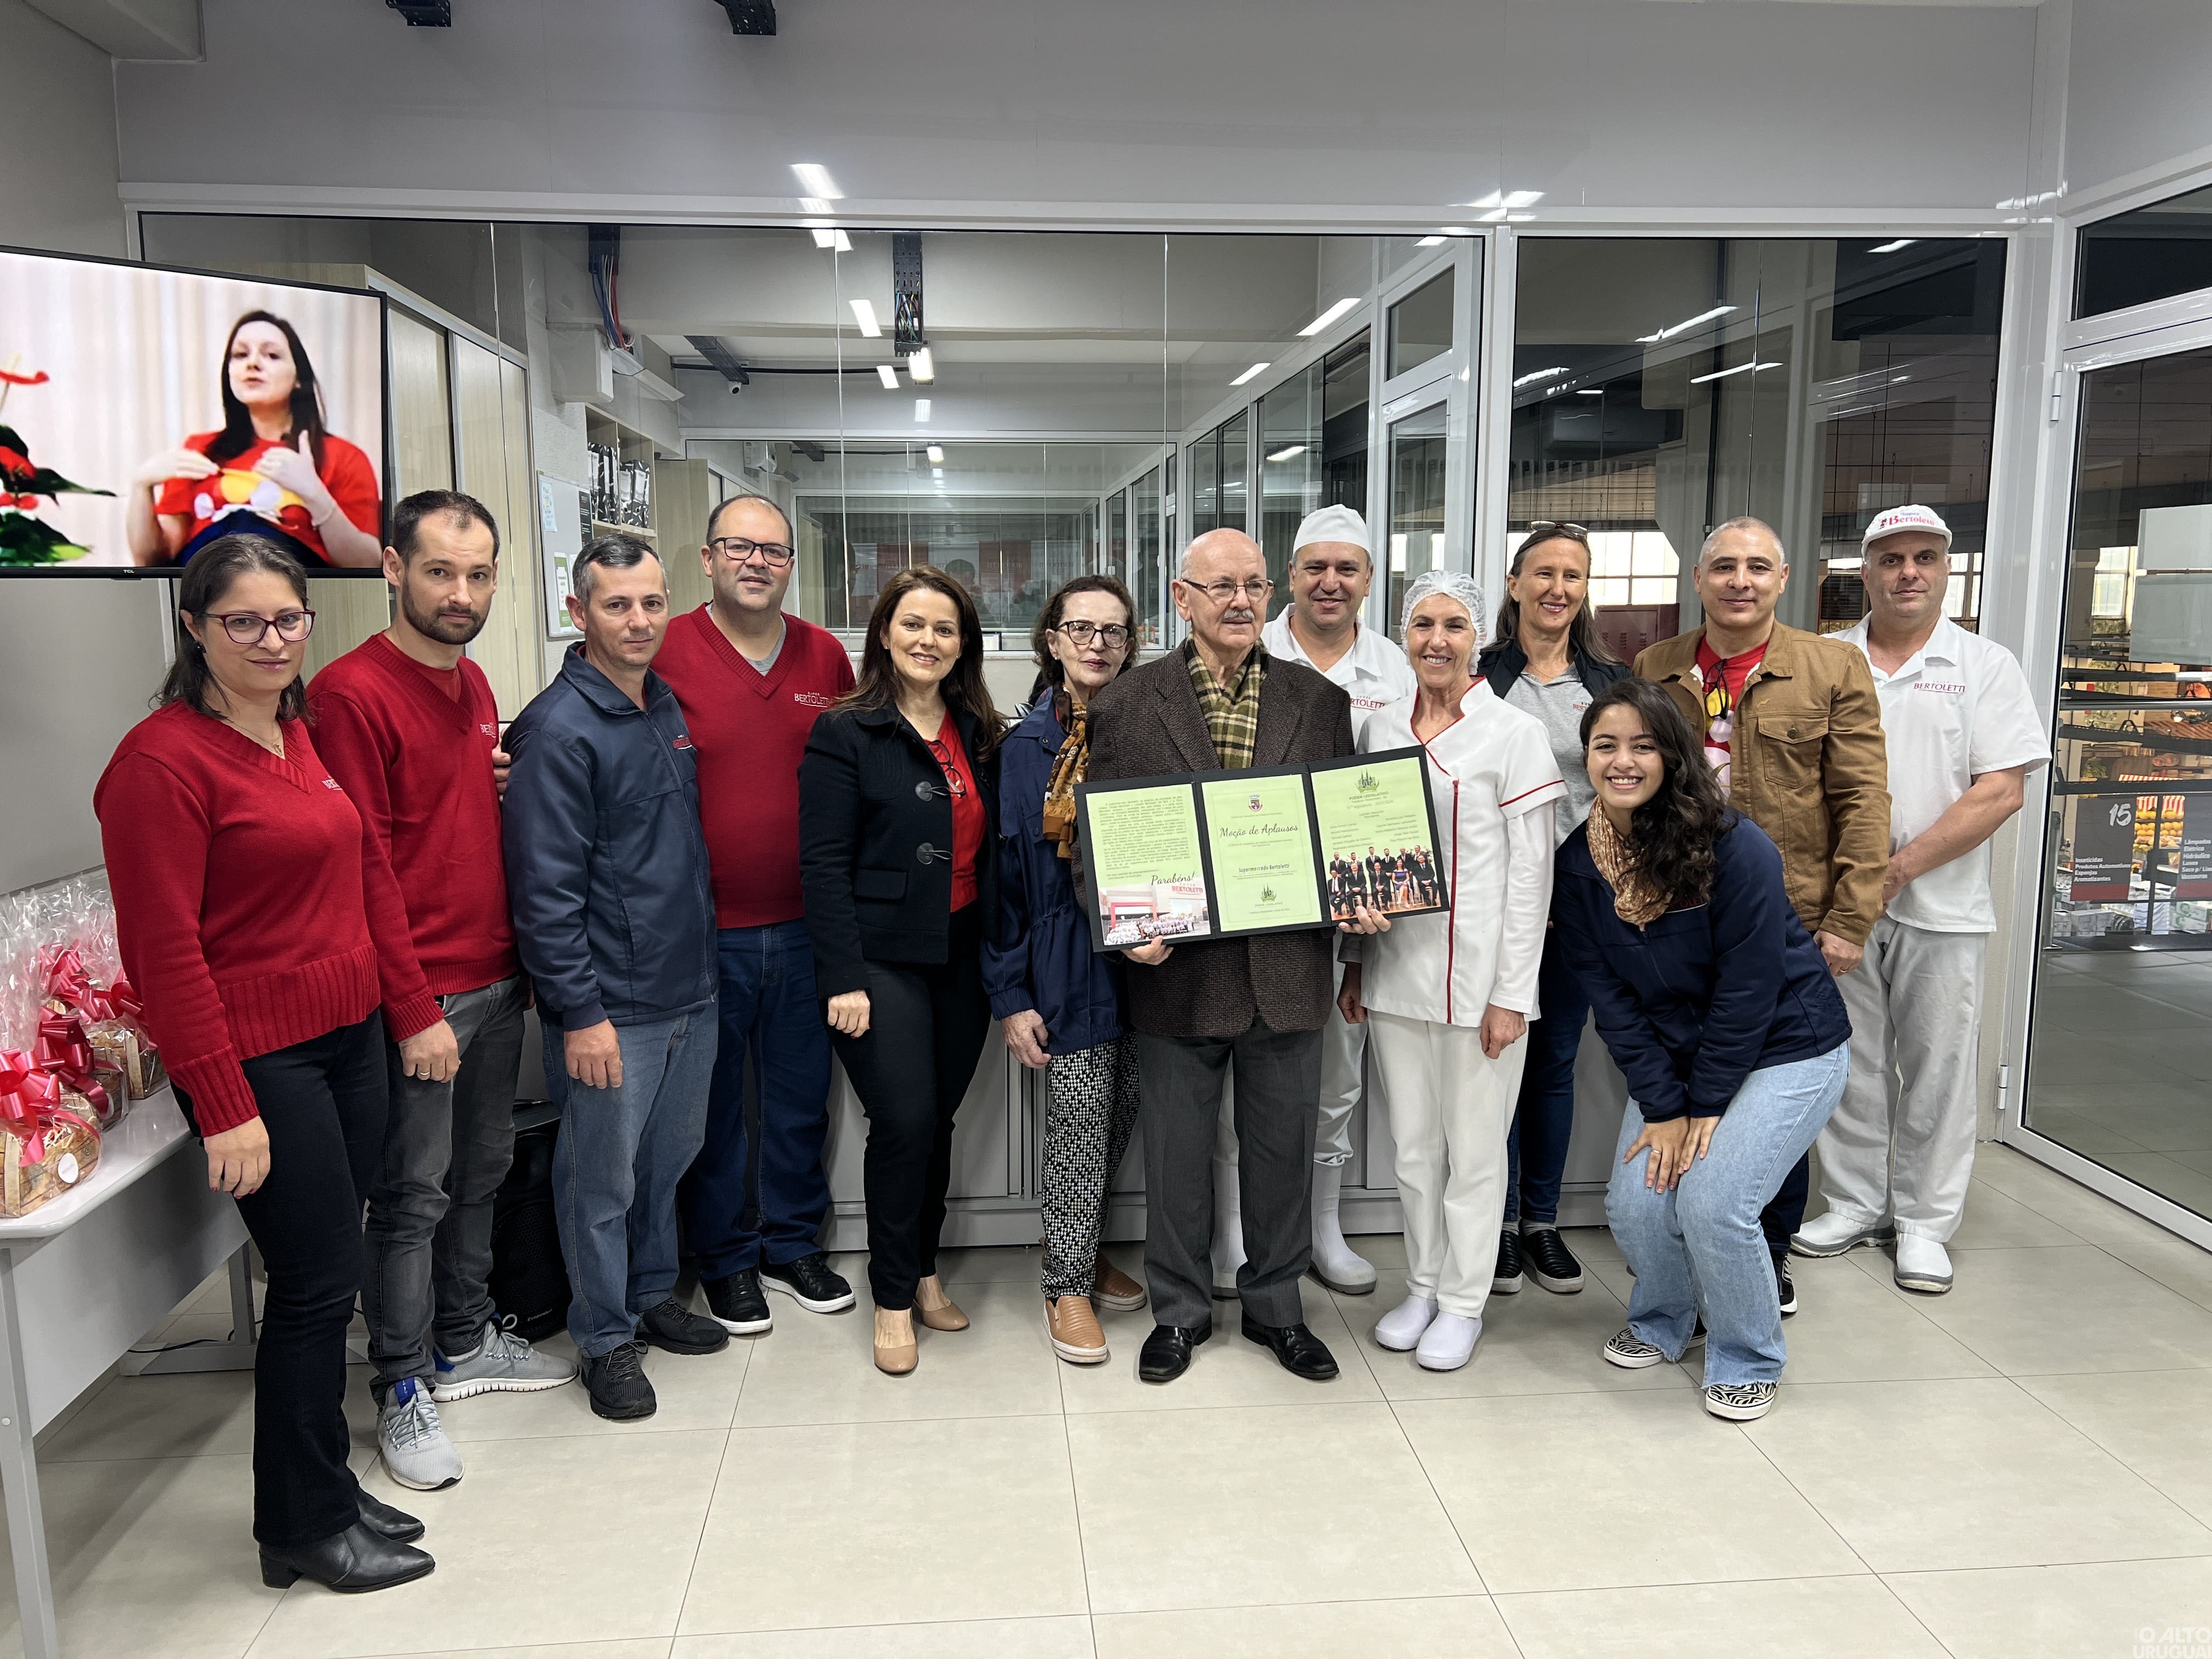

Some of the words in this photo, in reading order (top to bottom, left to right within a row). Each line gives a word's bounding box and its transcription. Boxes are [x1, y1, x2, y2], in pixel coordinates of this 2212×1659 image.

[1914, 683, 1965, 693] BERTOLETTI
[1350, 698, 1385, 709] RTOLETTI
[2109, 803, 2132, 827] 15
[1220, 827, 1247, 838] Moção
[1249, 825, 1259, 835] de
[1261, 823, 1299, 836] Aplausos
[1151, 871, 1195, 886] Parabéns!
